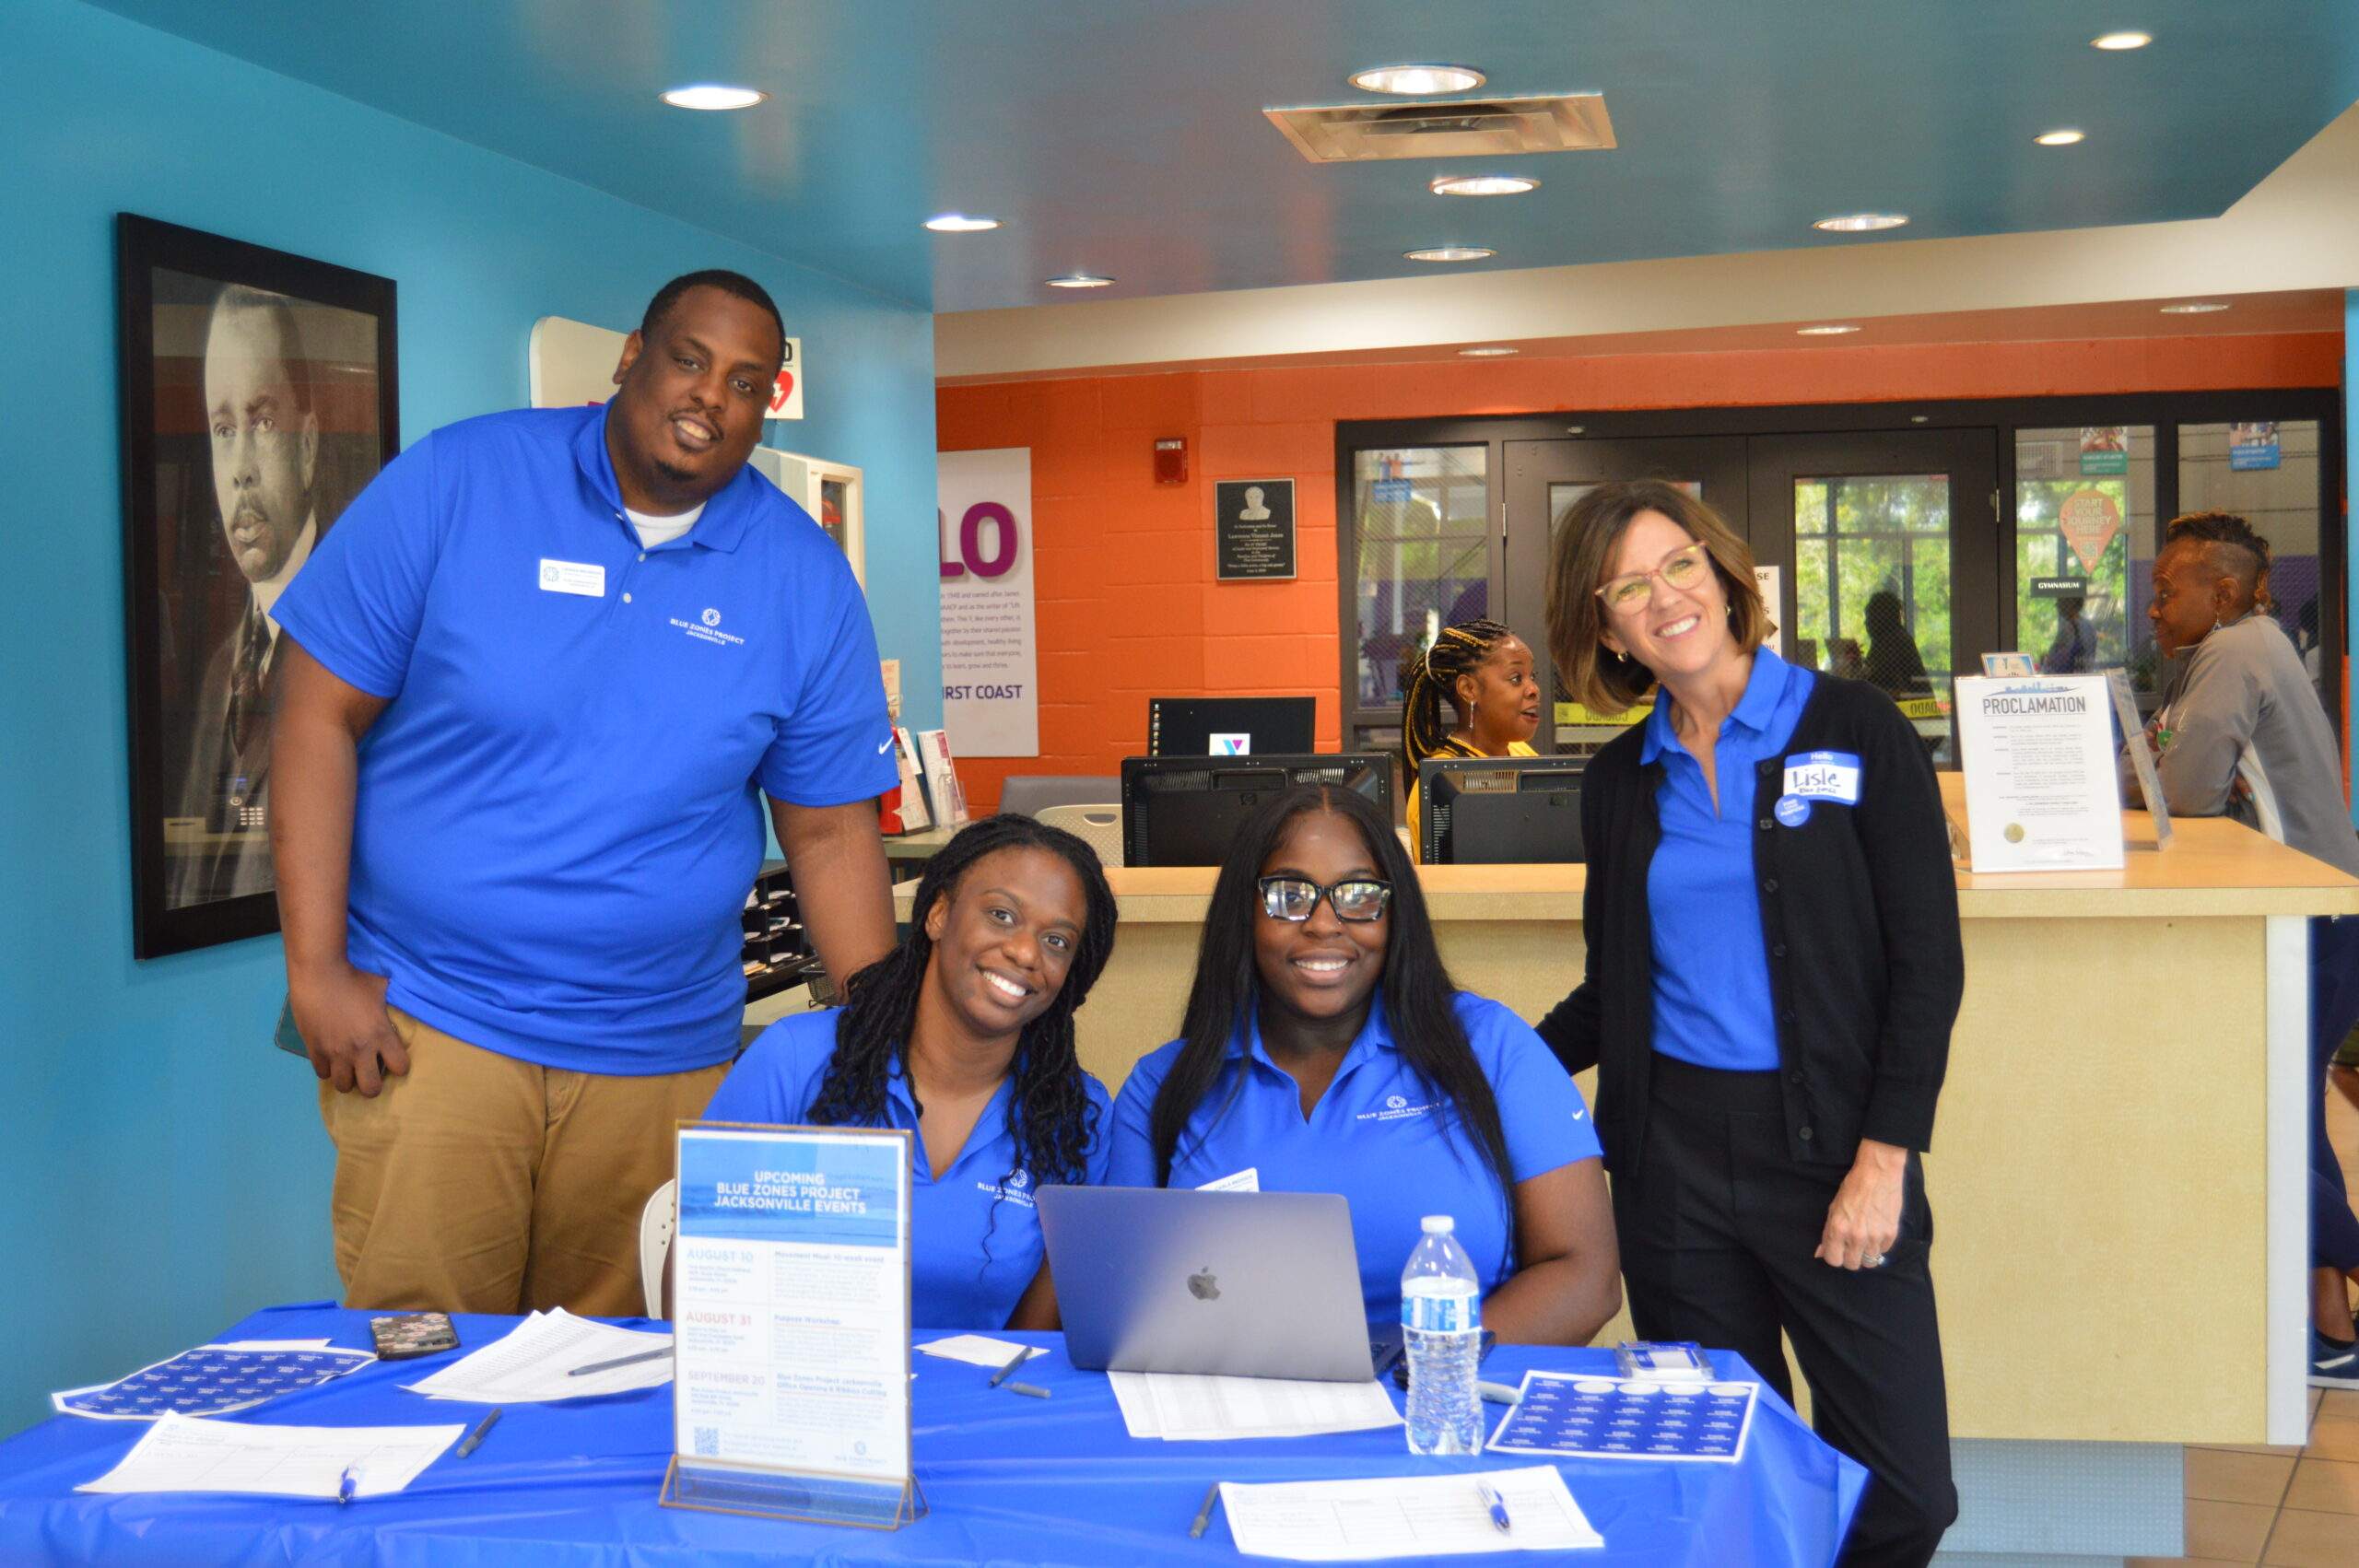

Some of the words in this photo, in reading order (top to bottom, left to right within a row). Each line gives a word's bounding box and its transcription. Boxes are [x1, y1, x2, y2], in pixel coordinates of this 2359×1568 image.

[670, 618, 688, 628] BLUE
[689, 623, 713, 636] ZONES
[714, 630, 745, 645] PROJECT
[976, 685, 1023, 699] COAST
[1983, 696, 2086, 714] PROCLAMATION
[1810, 753, 1834, 761] Hello
[1793, 767, 1841, 788] Lisle
[754, 1170, 826, 1186] UPCOMING
[717, 1182, 749, 1195] BLUE
[753, 1183, 797, 1198] ZONES
[801, 1186, 861, 1200] PROJECT
[977, 1182, 995, 1192] BLUE
[714, 1196, 811, 1211] JACKSONVILLE
[815, 1199, 866, 1214] EVENTS
[687, 1249, 735, 1262] AUGUST
[741, 1251, 754, 1263] 10
[686, 1312, 735, 1325] AUGUST
[740, 1314, 752, 1326] 31
[774, 1315, 803, 1323] Purpose
[687, 1370, 749, 1385] SEPTEMBER
[751, 1375, 765, 1387] 20
[793, 1374, 814, 1382] Zones
[816, 1375, 839, 1385] Project
[799, 1383, 827, 1393] Opening
